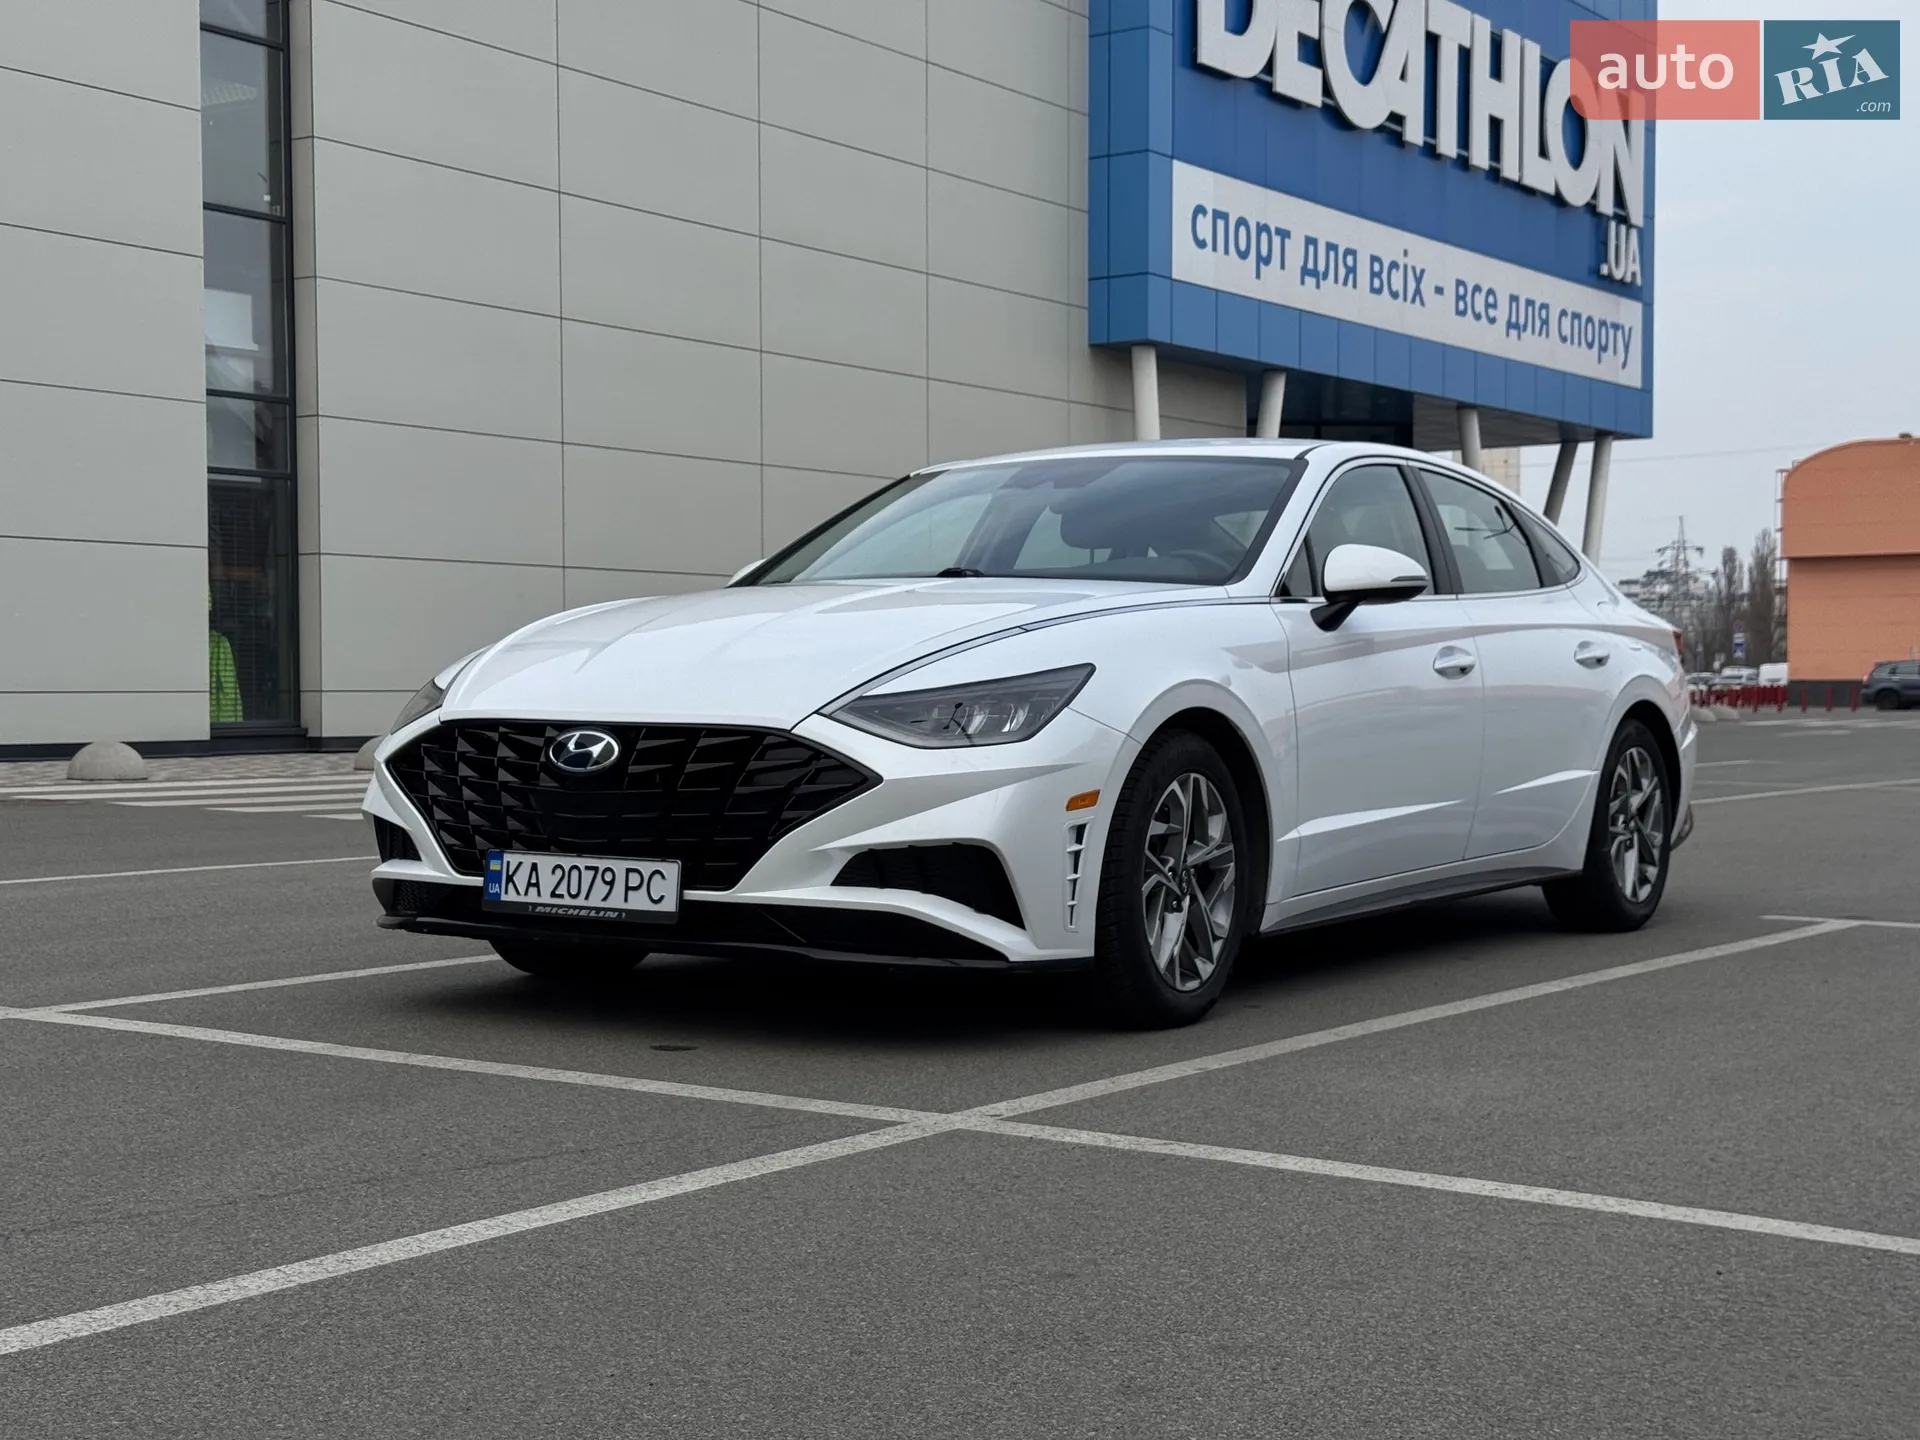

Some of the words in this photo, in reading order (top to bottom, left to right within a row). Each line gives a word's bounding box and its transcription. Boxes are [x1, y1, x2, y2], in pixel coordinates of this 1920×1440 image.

[1600, 220, 1642, 287] .UA
[1191, 204, 1292, 280] спорт
[1300, 234, 1358, 290] для
[1369, 249, 1426, 308] всіх
[1455, 278, 1498, 326] все
[1506, 293, 1550, 341] для
[1557, 308, 1633, 369] спорту
[489, 882, 500, 894] UA
[504, 860, 543, 897] KA
[550, 863, 617, 902] 2079
[624, 867, 668, 904] PC
[535, 906, 619, 919] MICHELIN
